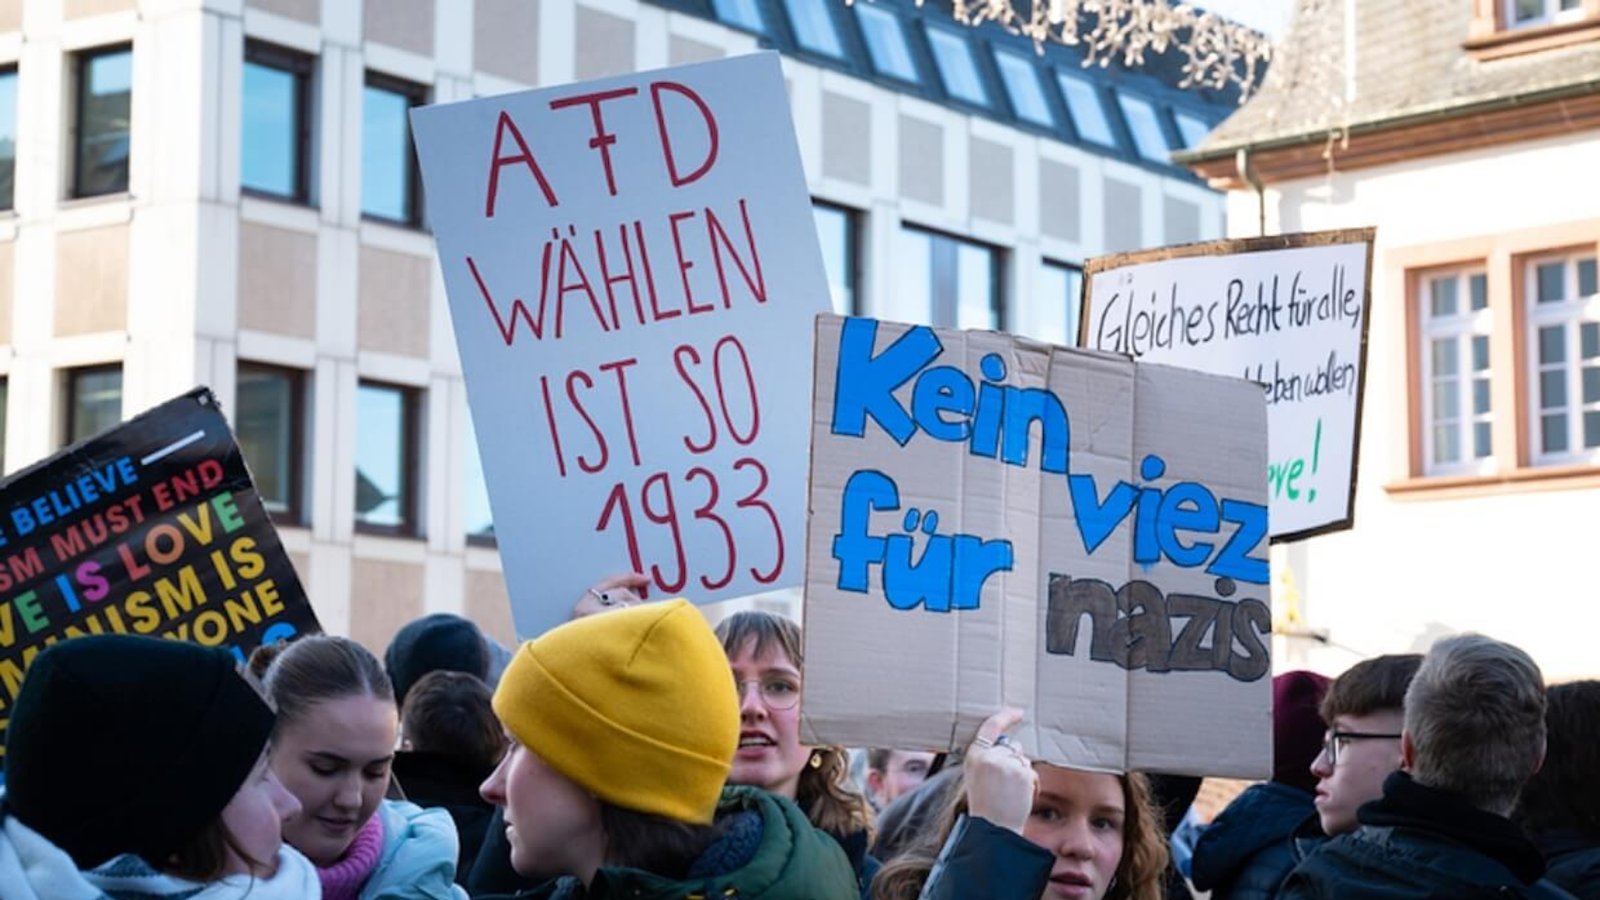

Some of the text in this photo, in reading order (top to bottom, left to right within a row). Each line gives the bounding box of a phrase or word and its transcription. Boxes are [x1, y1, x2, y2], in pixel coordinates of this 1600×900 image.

[466, 199, 767, 346] WÄHLEN
[1097, 282, 1218, 356] Gleiches
[1224, 274, 1282, 340] Recht
[1287, 271, 1317, 327] für
[541, 335, 760, 477] IST SO
[831, 316, 1270, 584] Kein viez
[10, 455, 139, 537] BELIEVE
[50, 494, 145, 562] MUST
[152, 458, 224, 512] END
[55, 561, 111, 613] IS
[117, 490, 245, 581] LOVE
[595, 457, 785, 600] 1933
[210, 536, 265, 591] IS
[832, 469, 1272, 682] für nazis
